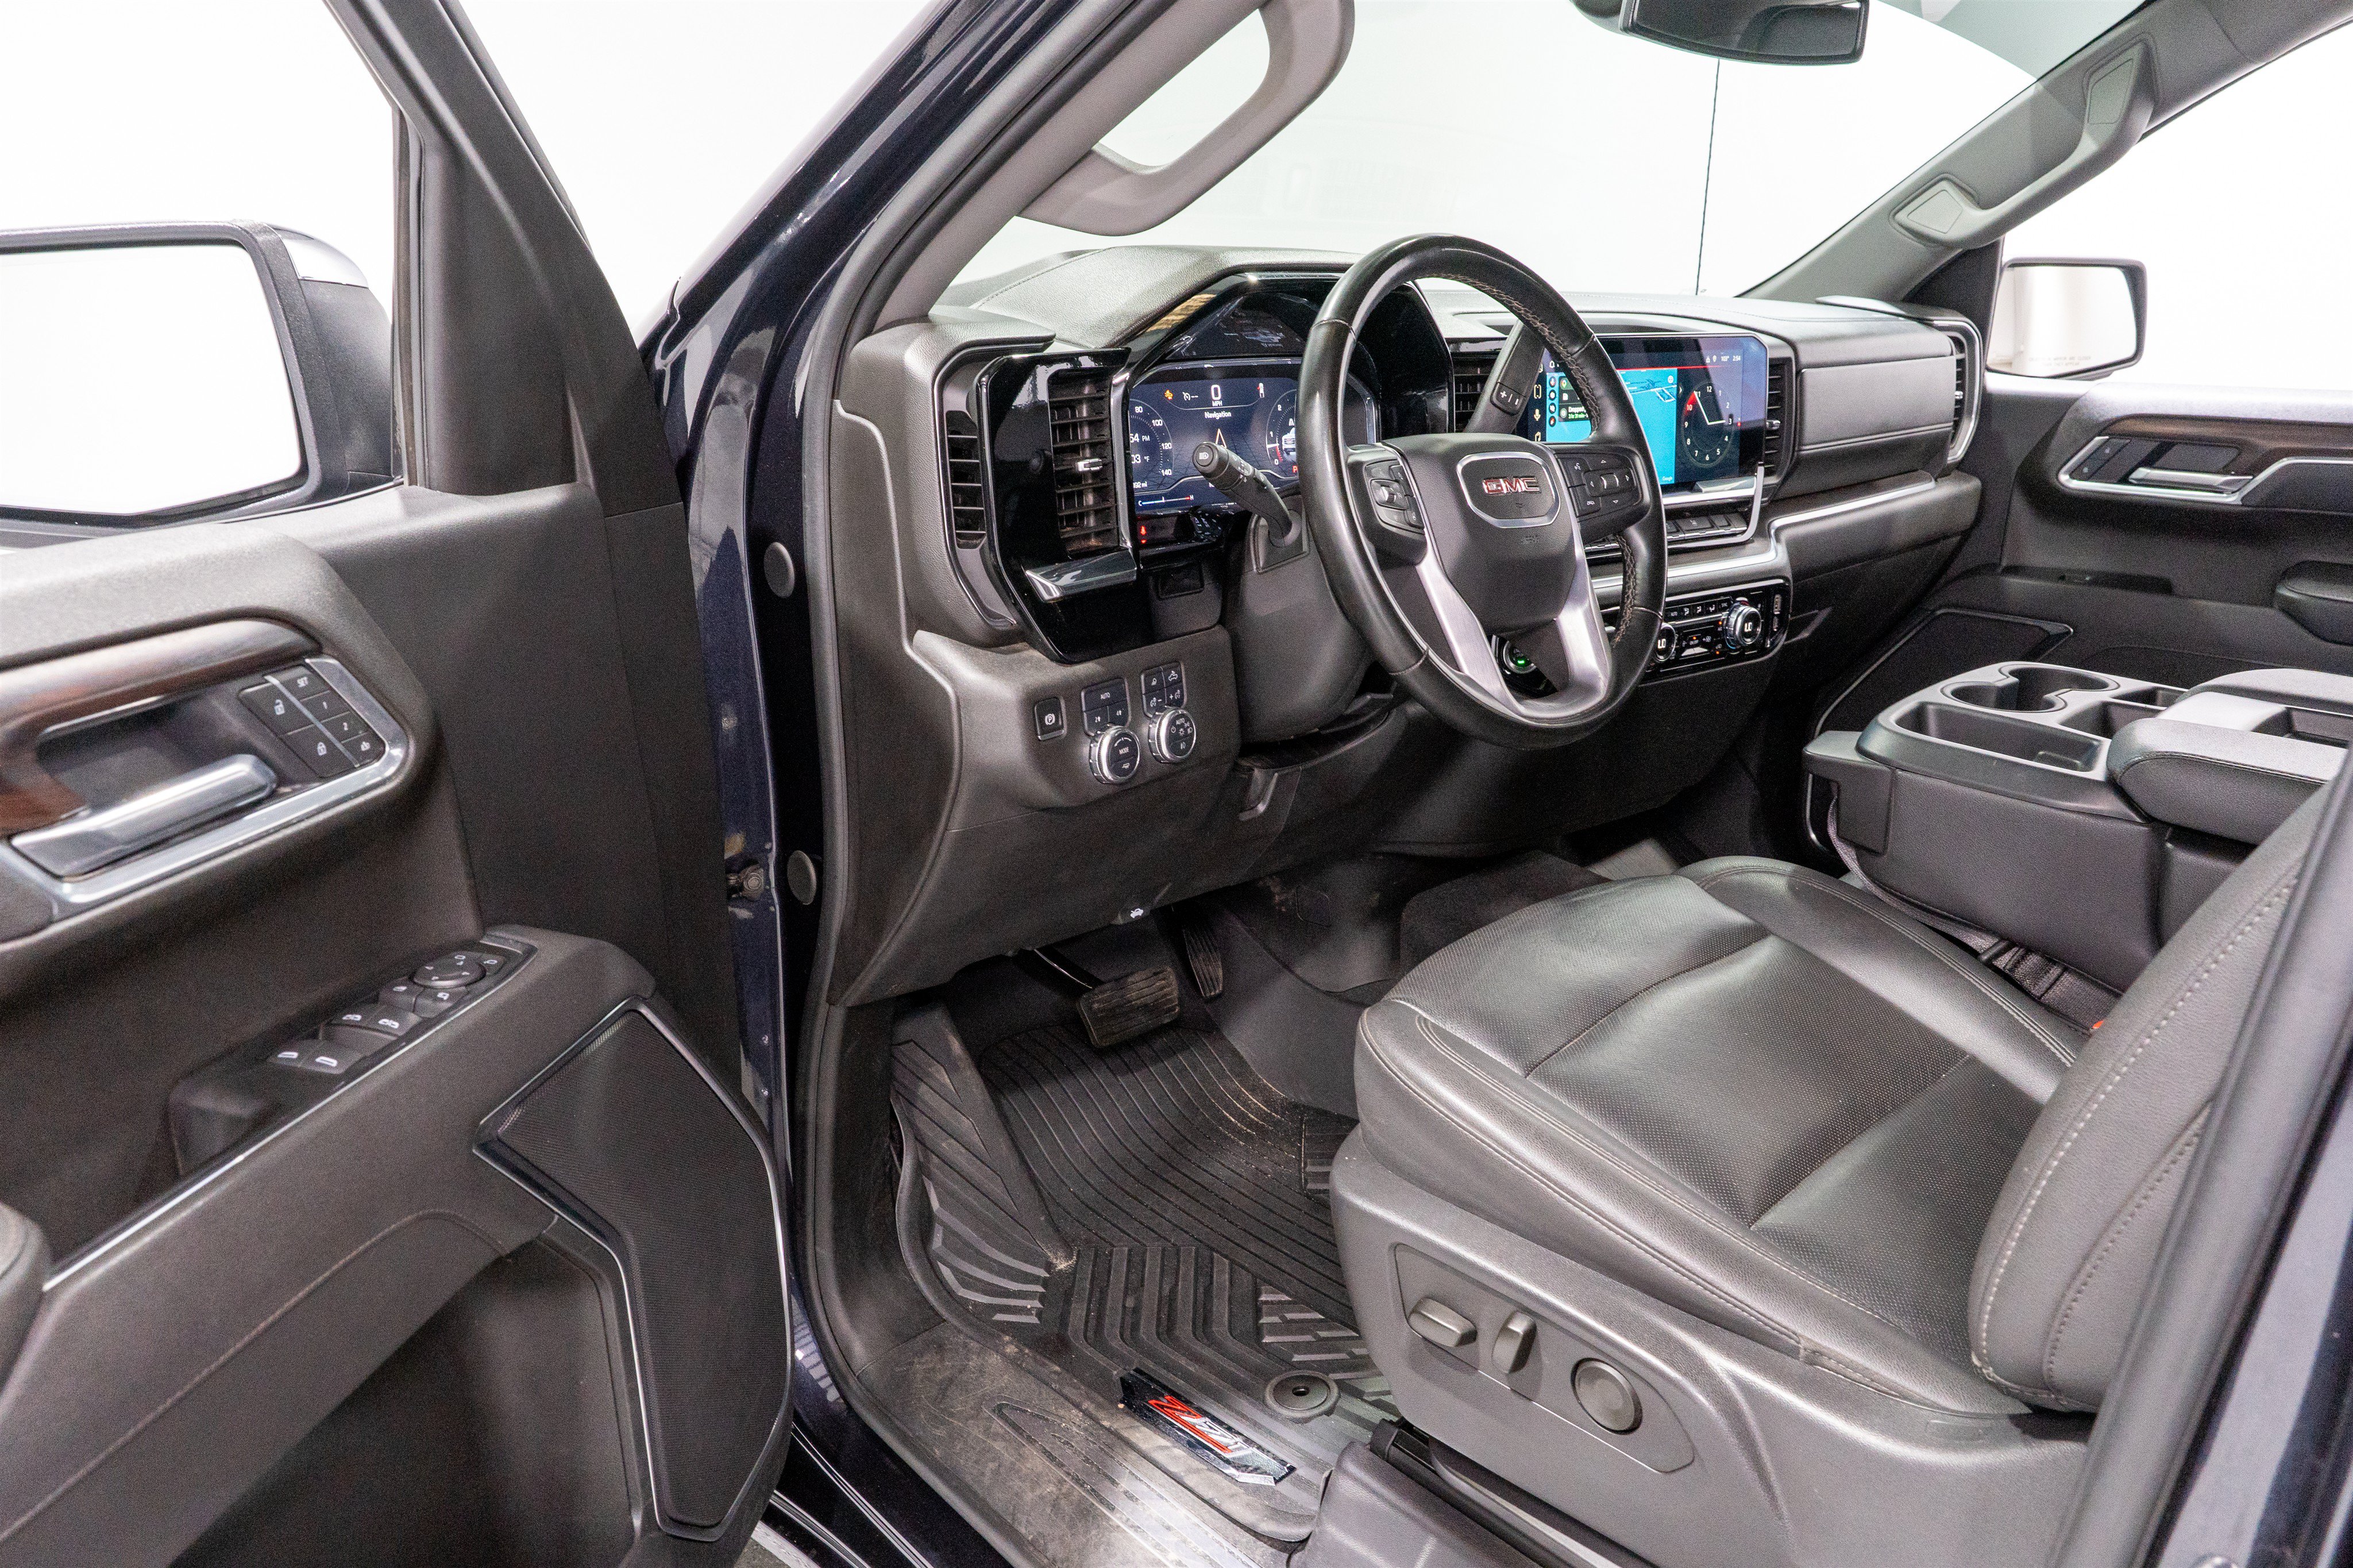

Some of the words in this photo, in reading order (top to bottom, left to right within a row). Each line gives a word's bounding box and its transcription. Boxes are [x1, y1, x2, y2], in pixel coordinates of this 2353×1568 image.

[1211, 384, 1221, 400] 0
[1204, 411, 1232, 419] Navigation
[1482, 477, 1541, 494] GMC
[1744, 622, 1752, 632] LO
[297, 677, 308, 688] SET
[343, 722, 348, 731] 2
[1119, 747, 1129, 755] MODE
